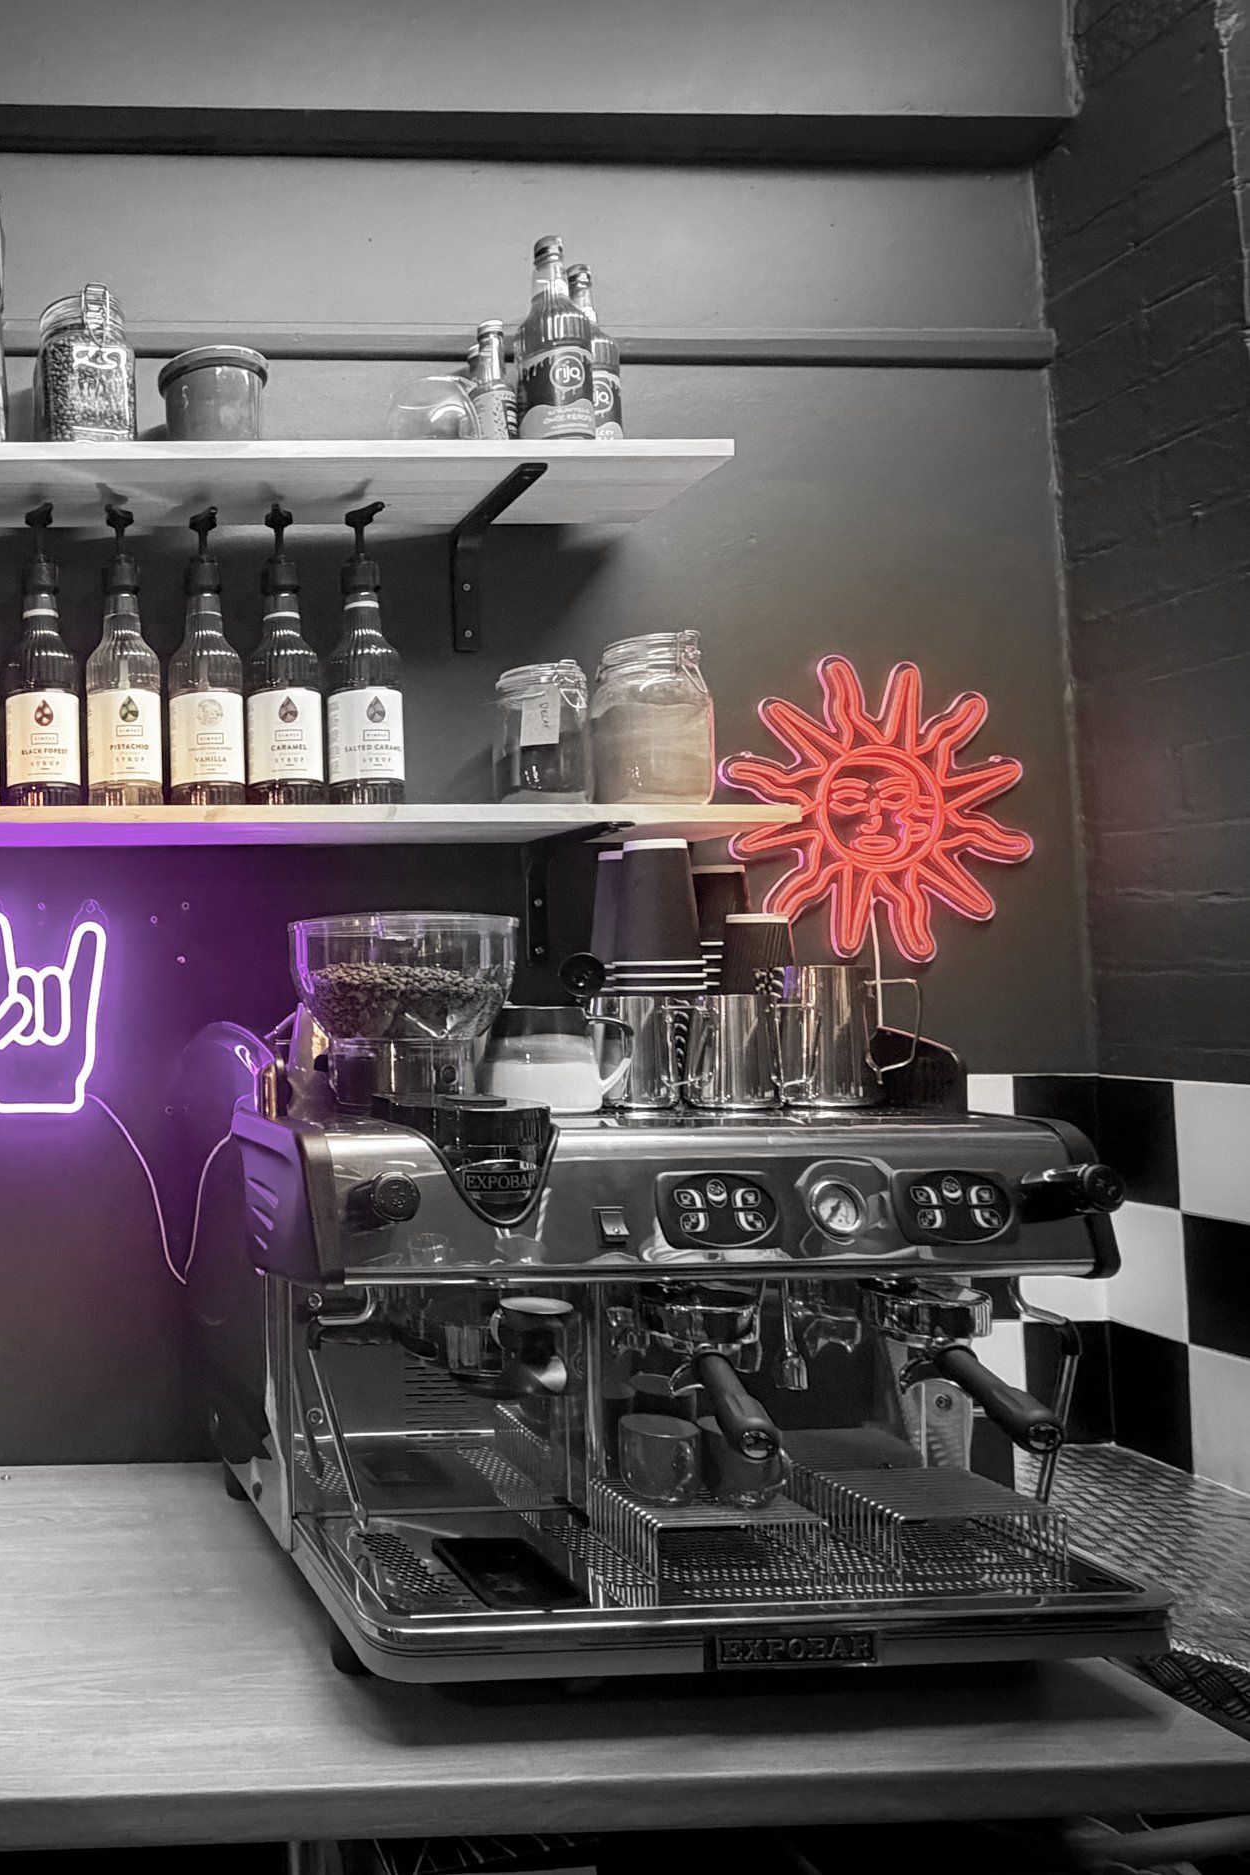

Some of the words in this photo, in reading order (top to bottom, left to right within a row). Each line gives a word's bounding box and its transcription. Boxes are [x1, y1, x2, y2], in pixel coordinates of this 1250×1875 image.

[344, 744, 372, 752] SALTED
[466, 1173, 536, 1189] EXPOBAR
[722, 1636, 869, 1661] EXPOBAR
